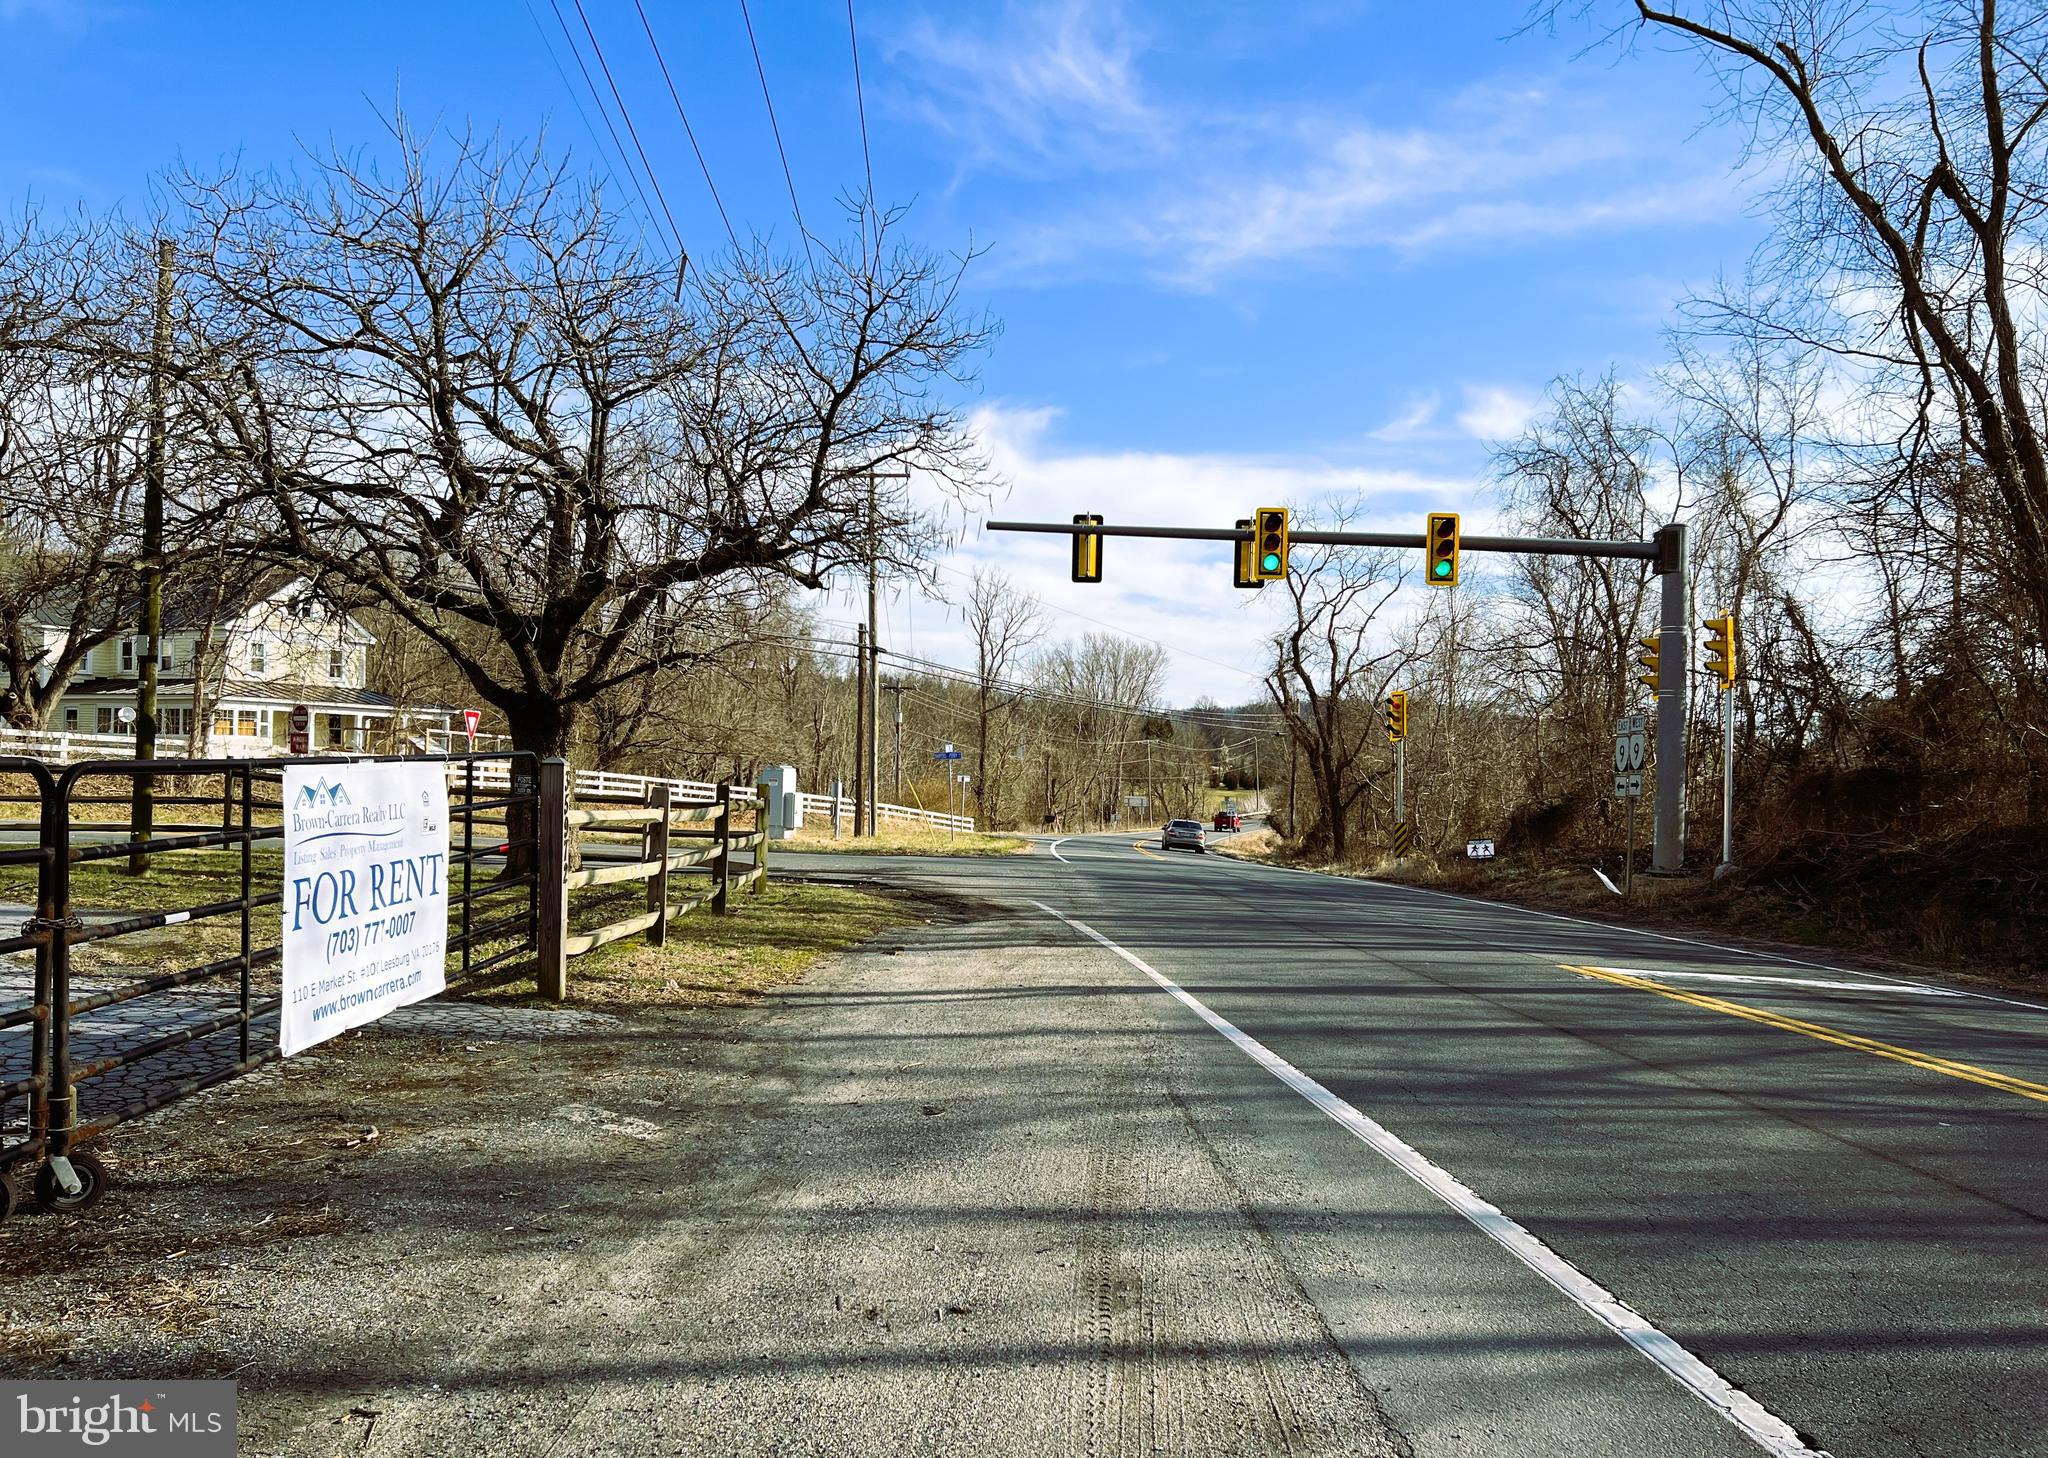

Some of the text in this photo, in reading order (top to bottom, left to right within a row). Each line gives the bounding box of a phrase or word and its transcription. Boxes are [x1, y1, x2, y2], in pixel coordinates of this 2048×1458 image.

[1632, 717, 1643, 728] WEST
[1620, 745, 1624, 762] 9
[1634, 743, 1639, 760] 9
[293, 810, 360, 832] Brown-Carrera
[388, 803, 406, 820] LLC
[293, 851, 317, 866] Listing
[320, 847, 337, 860] Sales
[340, 843, 367, 858] Property
[292, 853, 444, 932] FOR RENT
[326, 911, 416, 965] (703) 777-0007
[293, 985, 309, 1004] 110
[311, 982, 316, 997] E
[319, 975, 345, 994] Market
[381, 952, 410, 972] Leesburg
